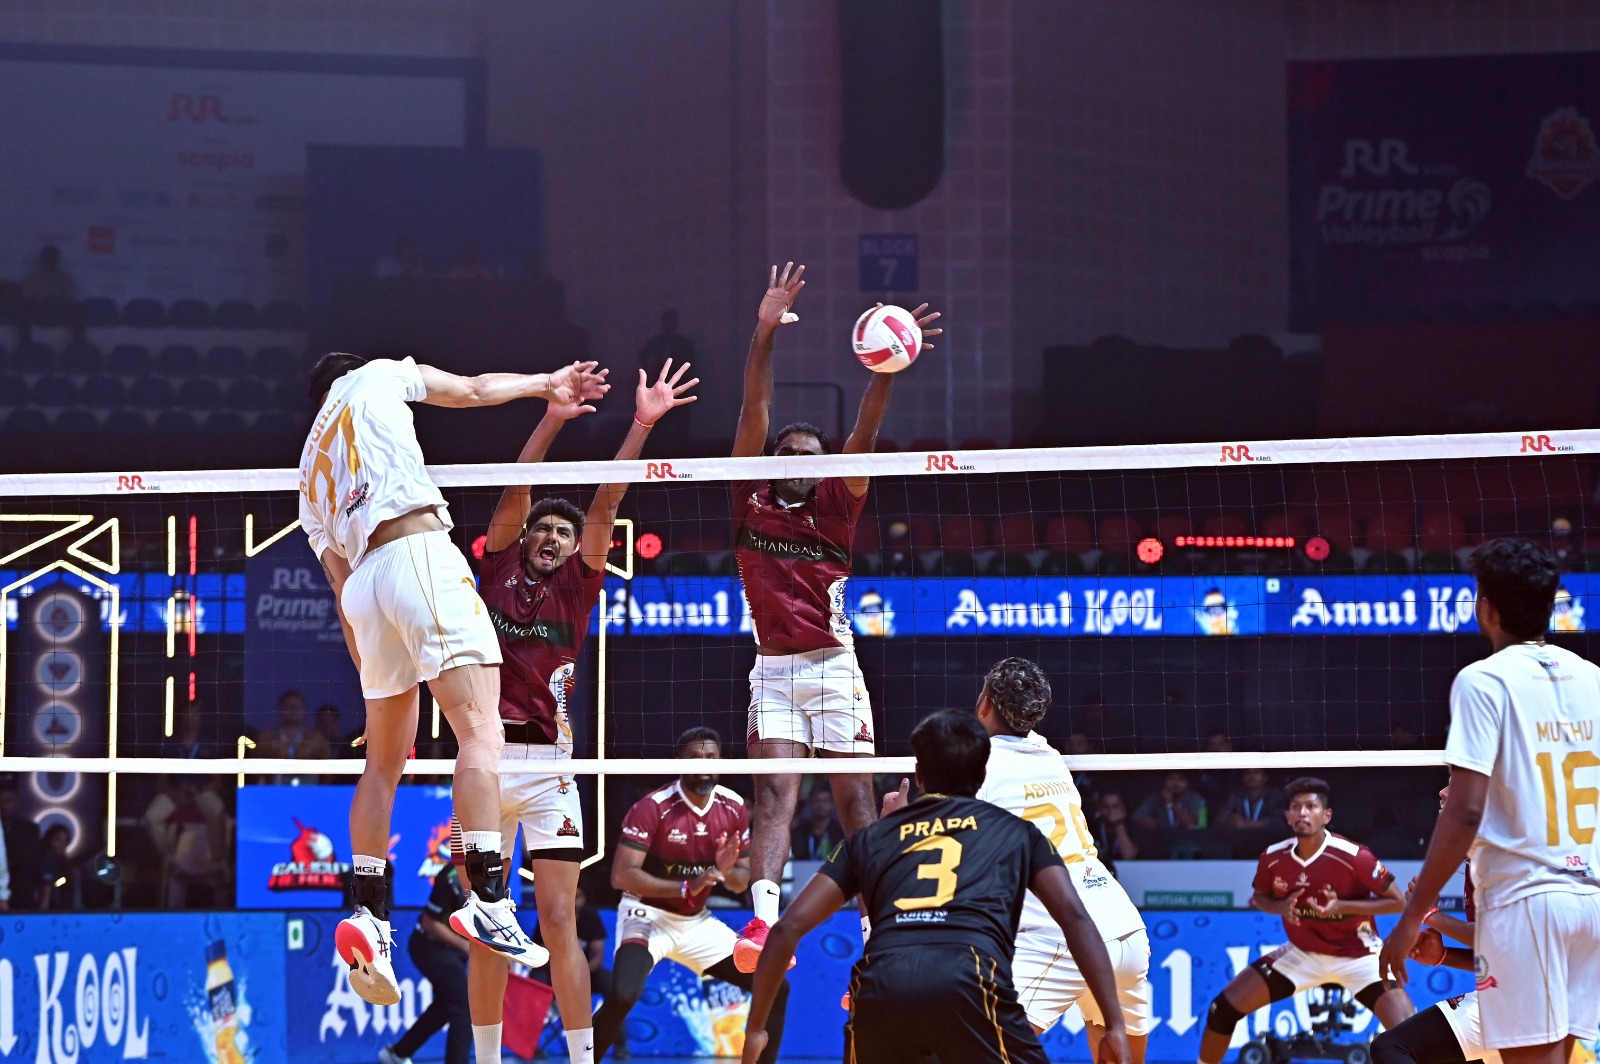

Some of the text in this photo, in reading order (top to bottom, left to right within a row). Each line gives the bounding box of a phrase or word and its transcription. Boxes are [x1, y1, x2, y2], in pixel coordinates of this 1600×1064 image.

[1341, 138, 1418, 178] RR
[1317, 184, 1442, 221] Prime
[880, 259, 898, 287] 7
[1220, 444, 1254, 462] RR
[1520, 435, 1556, 452] RR
[645, 462, 677, 479] RR
[925, 454, 958, 471] RR
[117, 475, 146, 491] RR
[271, 567, 317, 591] RR
[256, 594, 329, 618] Prime
[946, 588, 1163, 635] Amul KOOL
[1290, 587, 1478, 633] Amul KO
[1535, 720, 1593, 743] MUTHU
[1535, 751, 1600, 846] 16
[355, 865, 381, 875] MGL
[894, 835, 963, 911] 3
[1147, 894, 1228, 905] MUTUAL FUNDS
[34, 946, 150, 1064] KOOL
